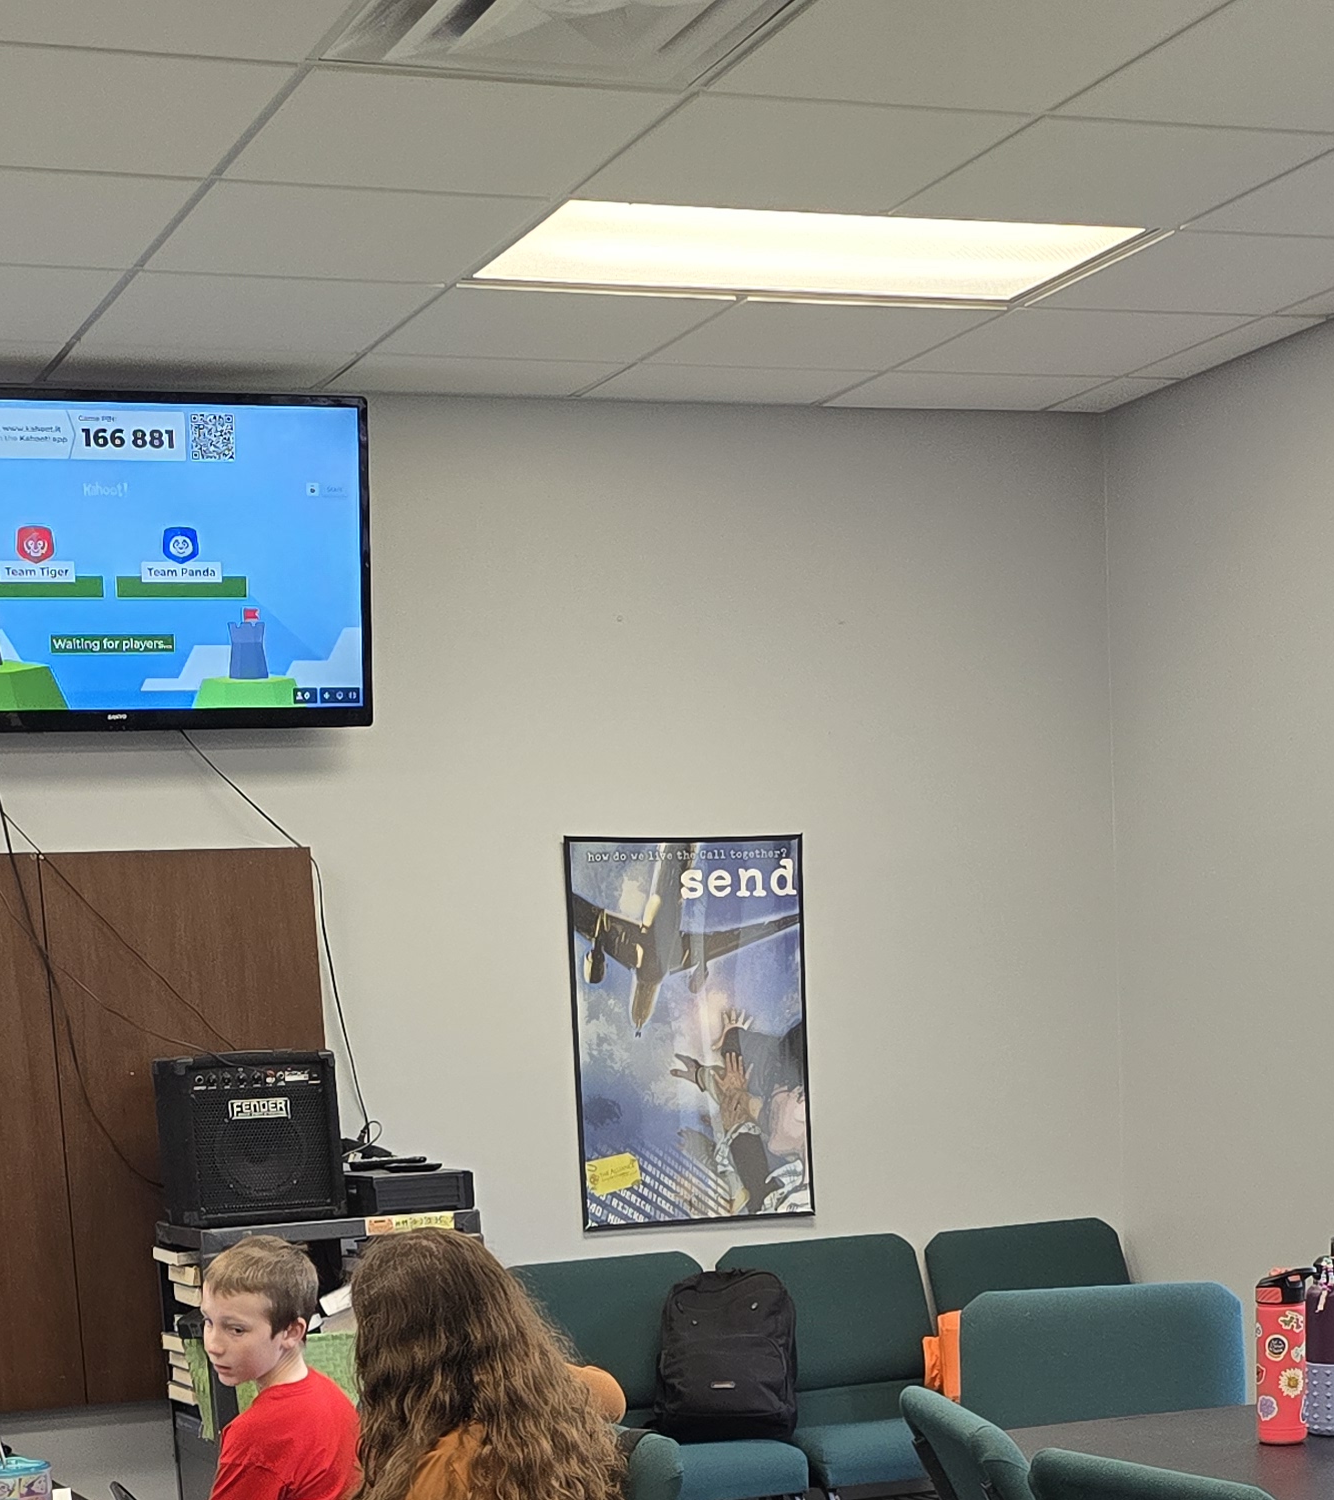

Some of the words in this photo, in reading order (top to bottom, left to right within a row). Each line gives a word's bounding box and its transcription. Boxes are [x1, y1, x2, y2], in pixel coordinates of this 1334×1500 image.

[81, 428, 125, 448] 166
[132, 429, 174, 448] 881
[83, 483, 128, 497] Kahoot!
[5, 567, 36, 577] Team
[39, 566, 69, 578] Tiger
[147, 567, 177, 577] Team
[181, 567, 216, 577] Panda
[53, 639, 100, 651] Waiting
[103, 638, 119, 649] for
[588, 852, 609, 862] how
[613, 852, 626, 861] do
[631, 853, 645, 861] we
[648, 851, 672, 860] live
[677, 851, 695, 860] the
[700, 850, 726, 860] Call
[730, 848, 787, 860] together?
[681, 859, 797, 899] send
